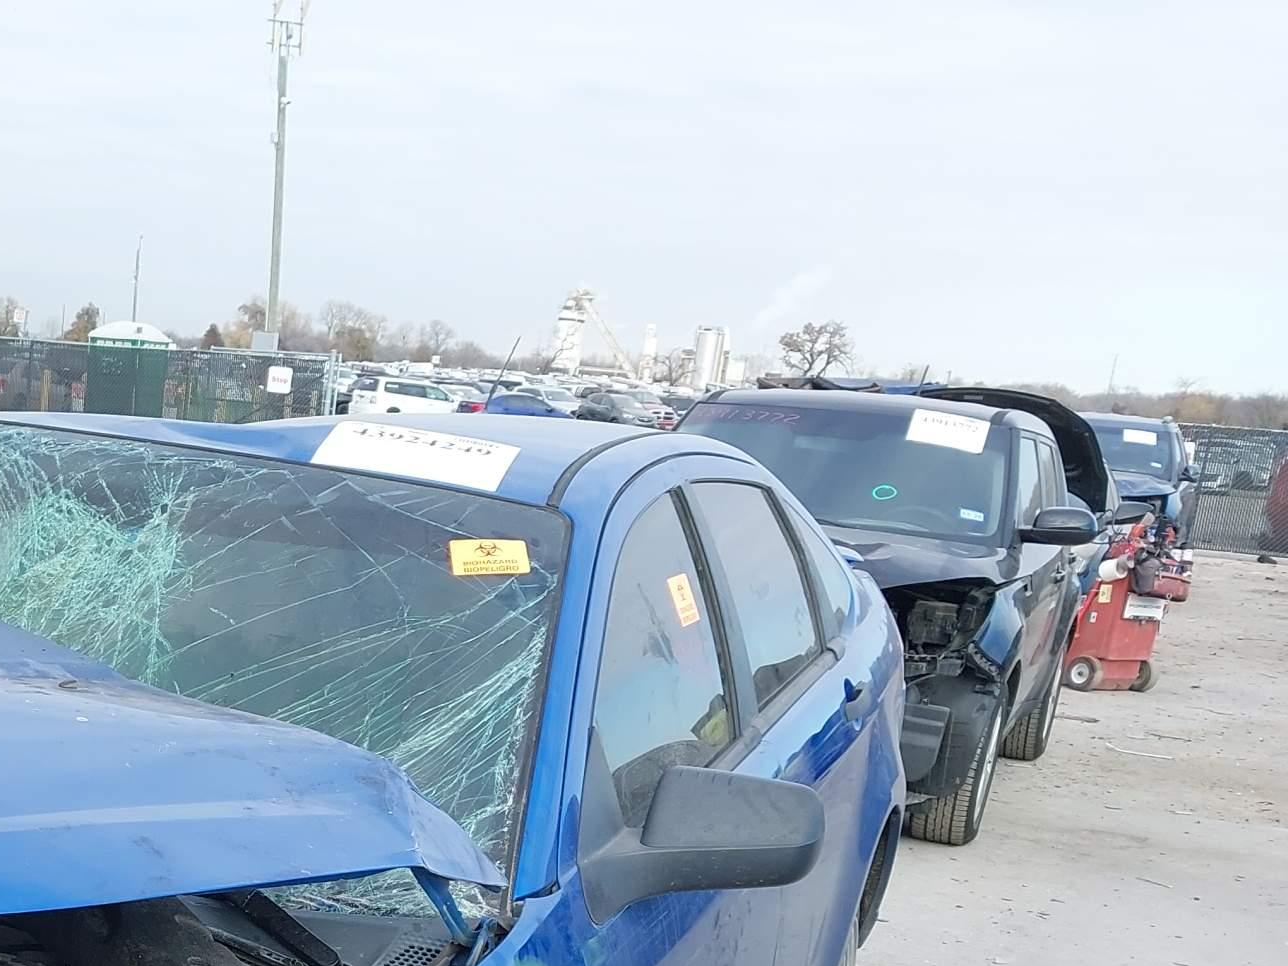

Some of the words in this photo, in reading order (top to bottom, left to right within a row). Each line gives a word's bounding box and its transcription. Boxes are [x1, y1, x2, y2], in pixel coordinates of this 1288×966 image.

[353, 428, 492, 456] 43924249
[462, 559, 518, 567] BIOHAZARD
[463, 565, 519, 573] BIOPELIGRO
